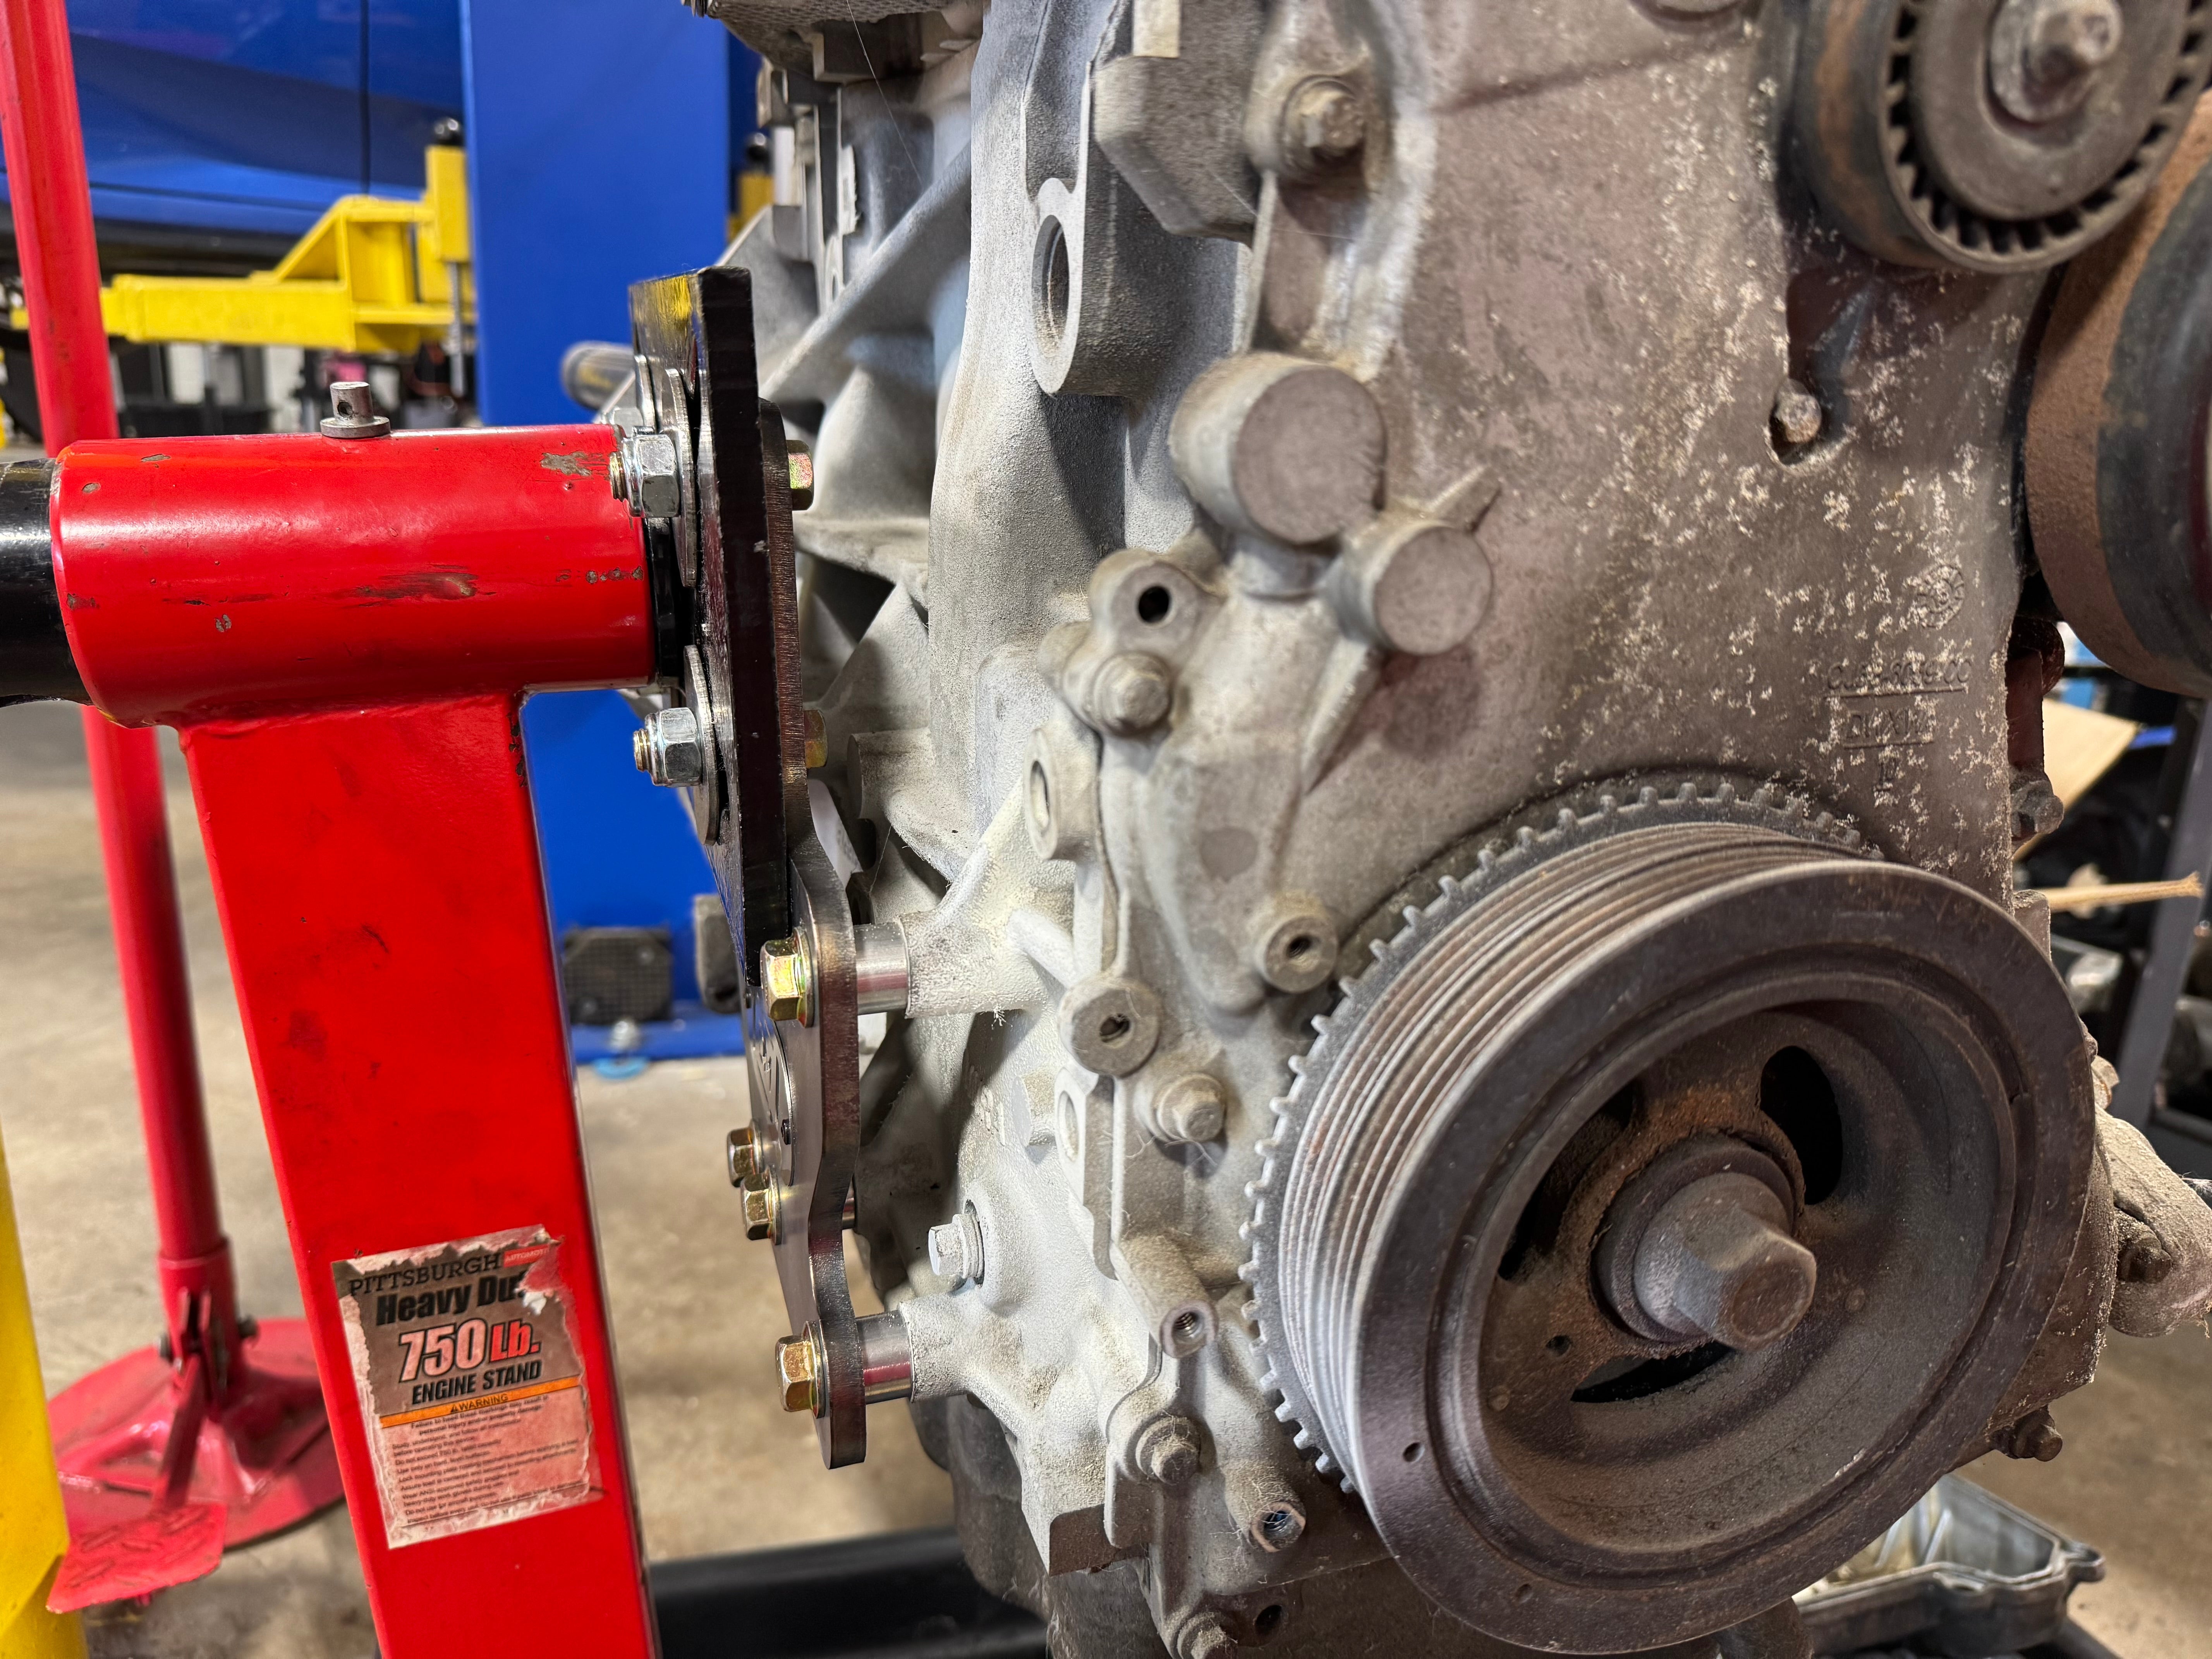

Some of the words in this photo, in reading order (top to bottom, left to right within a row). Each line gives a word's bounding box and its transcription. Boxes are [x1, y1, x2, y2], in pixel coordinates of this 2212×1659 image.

[349, 1253, 501, 1296] PITTSBURGH
[376, 1284, 473, 1326] Heavy
[399, 1318, 488, 1383] 750
[489, 1318, 542, 1363] Lb.
[412, 1373, 477, 1405] ENGINE
[483, 1359, 543, 1391] STAND
[460, 1393, 508, 1411] WARNING
